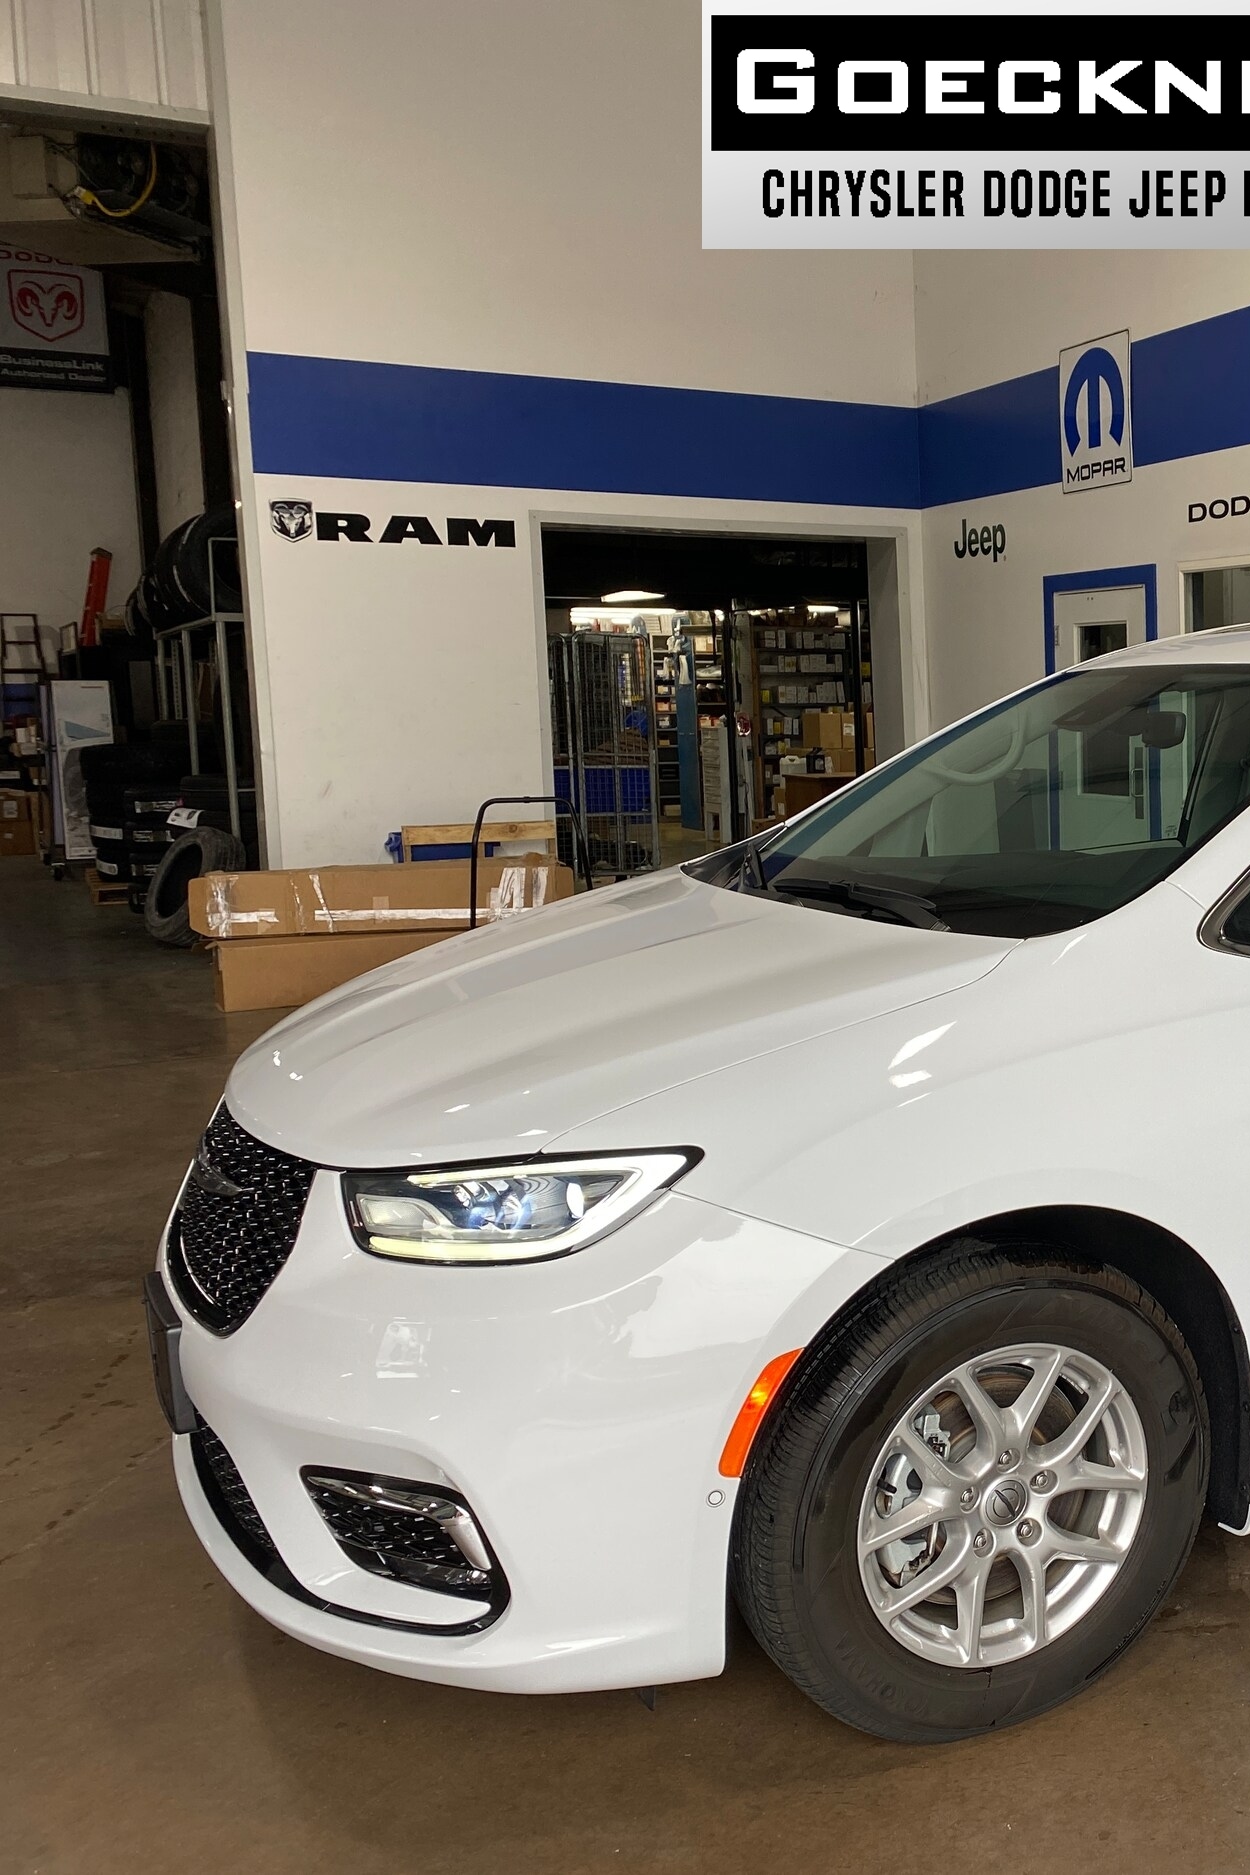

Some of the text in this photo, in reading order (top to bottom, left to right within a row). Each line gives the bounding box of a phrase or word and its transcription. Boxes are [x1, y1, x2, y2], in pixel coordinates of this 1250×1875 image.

[1066, 456, 1127, 484] MOPAR
[315, 512, 516, 548] RAM
[954, 518, 1006, 562] Jeep
